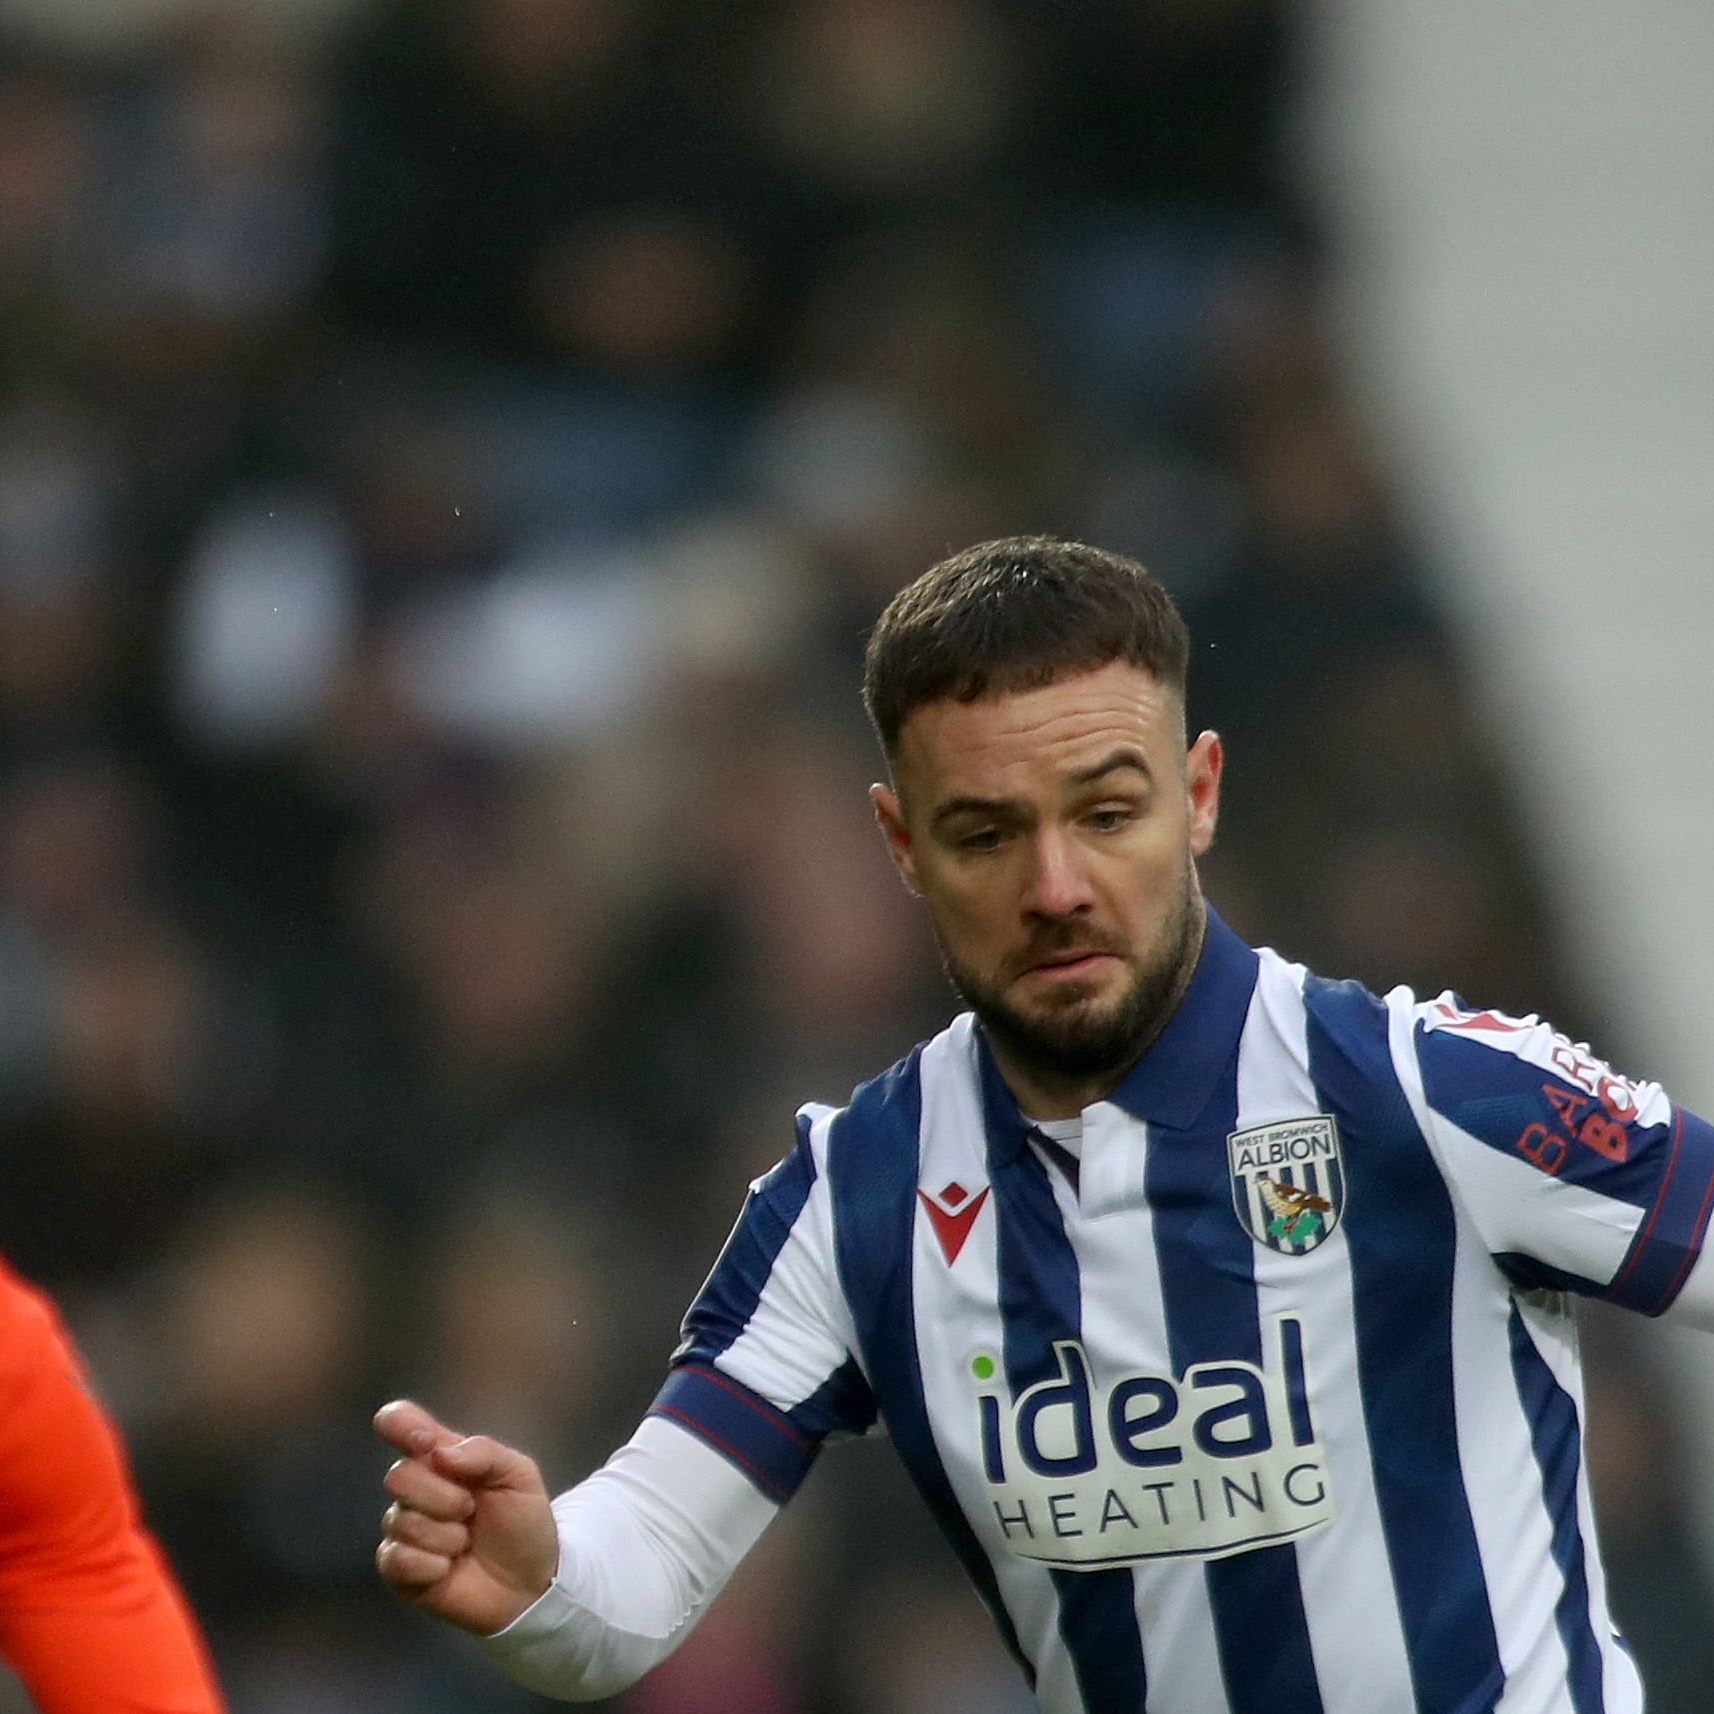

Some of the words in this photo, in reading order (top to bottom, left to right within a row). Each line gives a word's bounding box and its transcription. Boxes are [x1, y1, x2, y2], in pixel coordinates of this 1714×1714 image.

[1234, 1134, 1264, 1148] WEST
[1516, 1045, 1596, 1177] BAR
[1578, 1076, 1639, 1163] BO
[1237, 1133, 1331, 1172] ALBION
[971, 1317, 1316, 1485] ideal
[993, 1463, 1327, 1540] HEATING
